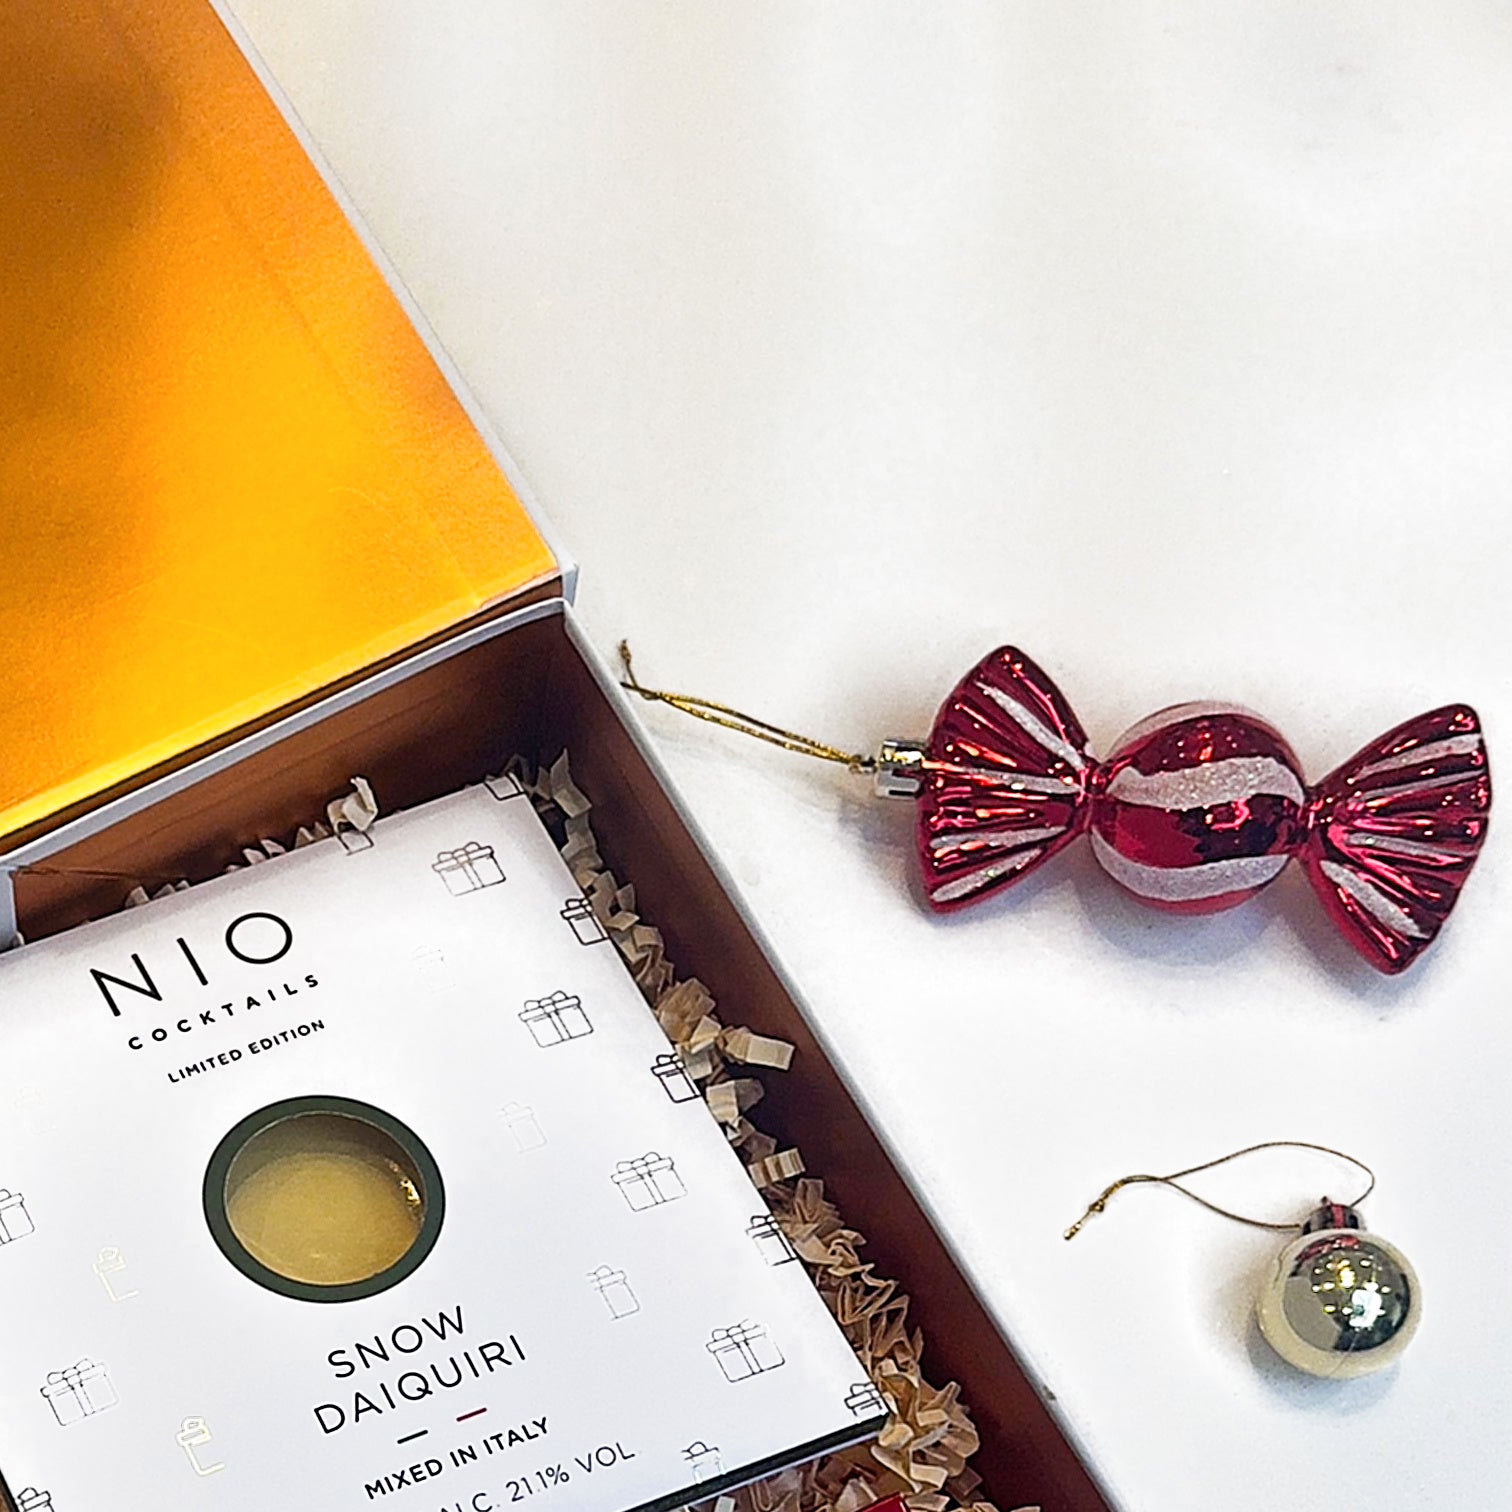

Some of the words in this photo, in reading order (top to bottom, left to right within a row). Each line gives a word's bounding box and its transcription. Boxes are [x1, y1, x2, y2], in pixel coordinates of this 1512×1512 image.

[89, 912, 293, 1017] NIO
[128, 974, 319, 1050] COCKTAILS
[168, 1047, 243, 1084] LIMITED
[248, 1019, 325, 1055] EDITION
[327, 1305, 465, 1378] SNOW
[313, 1335, 526, 1434] DAIQUIRI
[364, 1458, 444, 1500] MIXED
[449, 1444, 479, 1468] IN
[483, 1416, 548, 1455] ITALY
[506, 1464, 570, 1502] 21.1%
[575, 1441, 635, 1473] VOL
